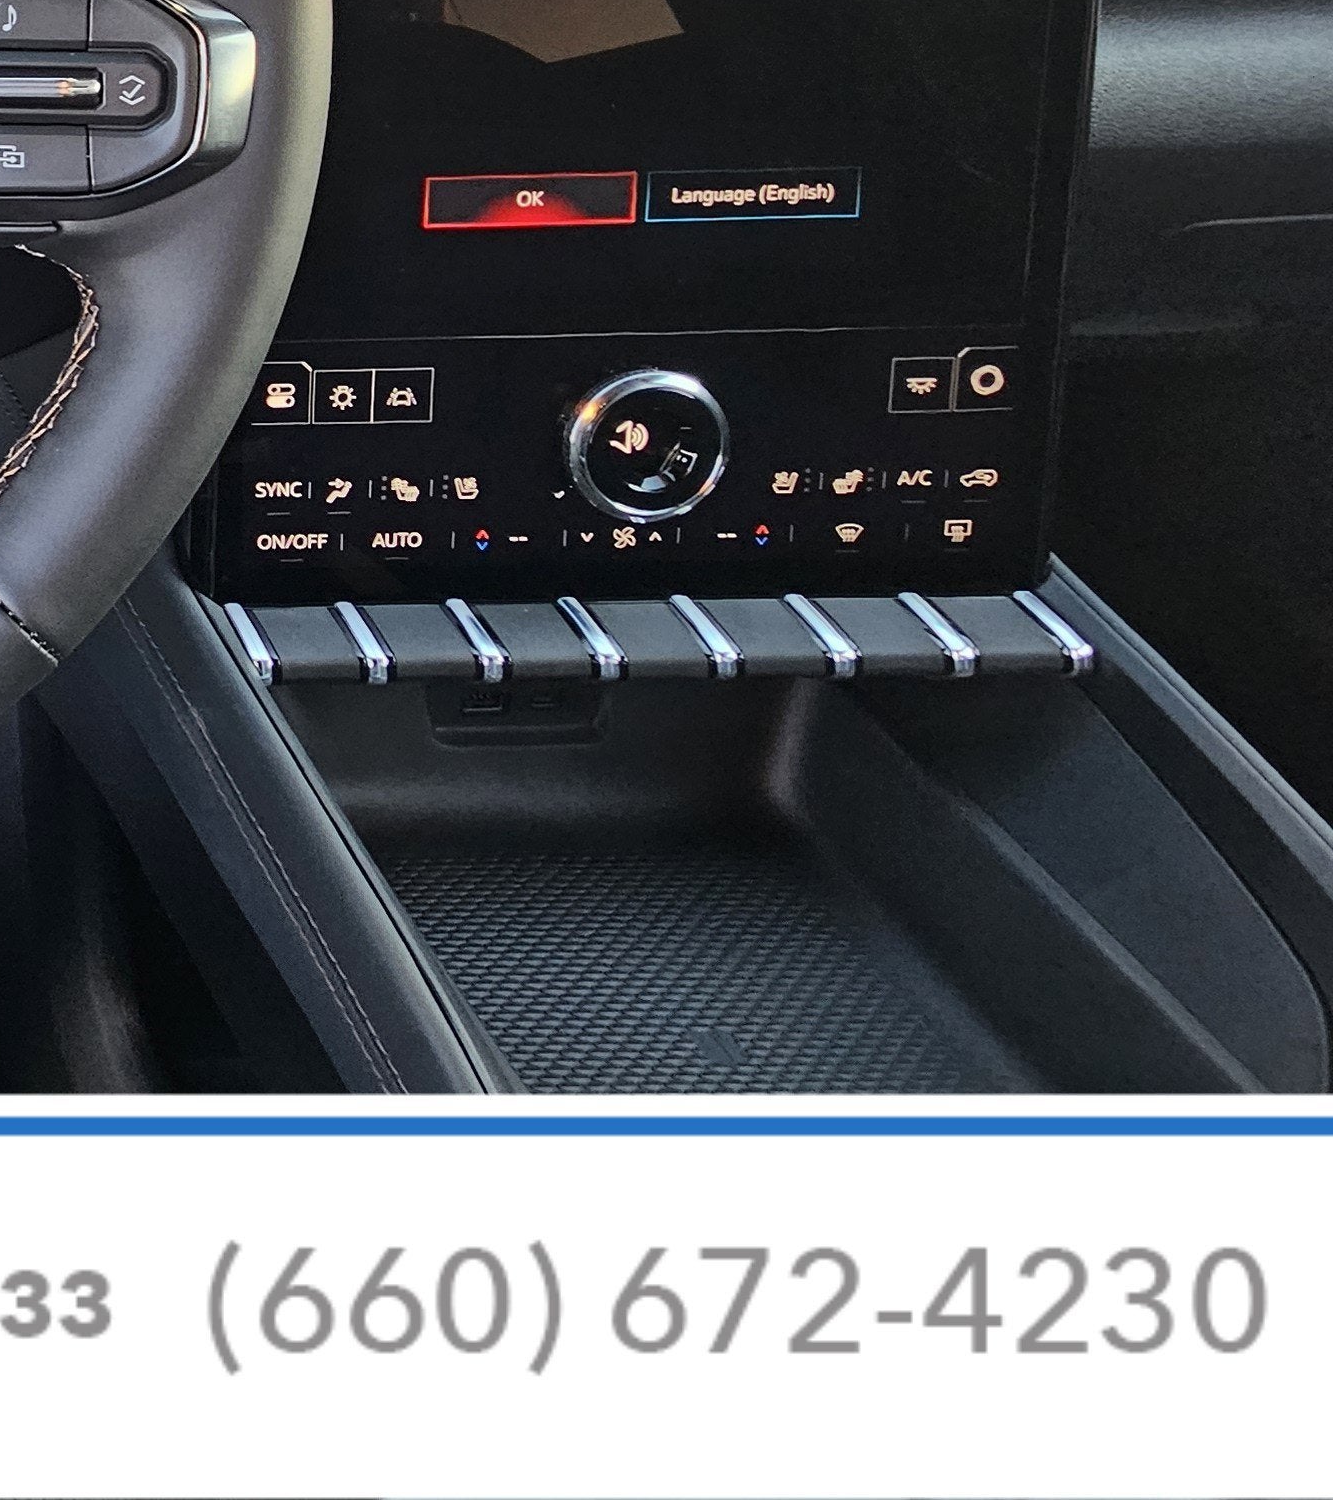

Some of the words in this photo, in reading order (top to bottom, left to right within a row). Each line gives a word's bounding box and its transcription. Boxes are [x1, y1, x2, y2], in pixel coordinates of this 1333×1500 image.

[515, 190, 545, 208] OK
[671, 187, 757, 207] Language
[758, 183, 835, 206] (English)
[896, 469, 934, 487] A/C
[254, 480, 303, 500] SYNC
[256, 531, 329, 551] ON/OFF
[371, 530, 423, 549] AUTO
